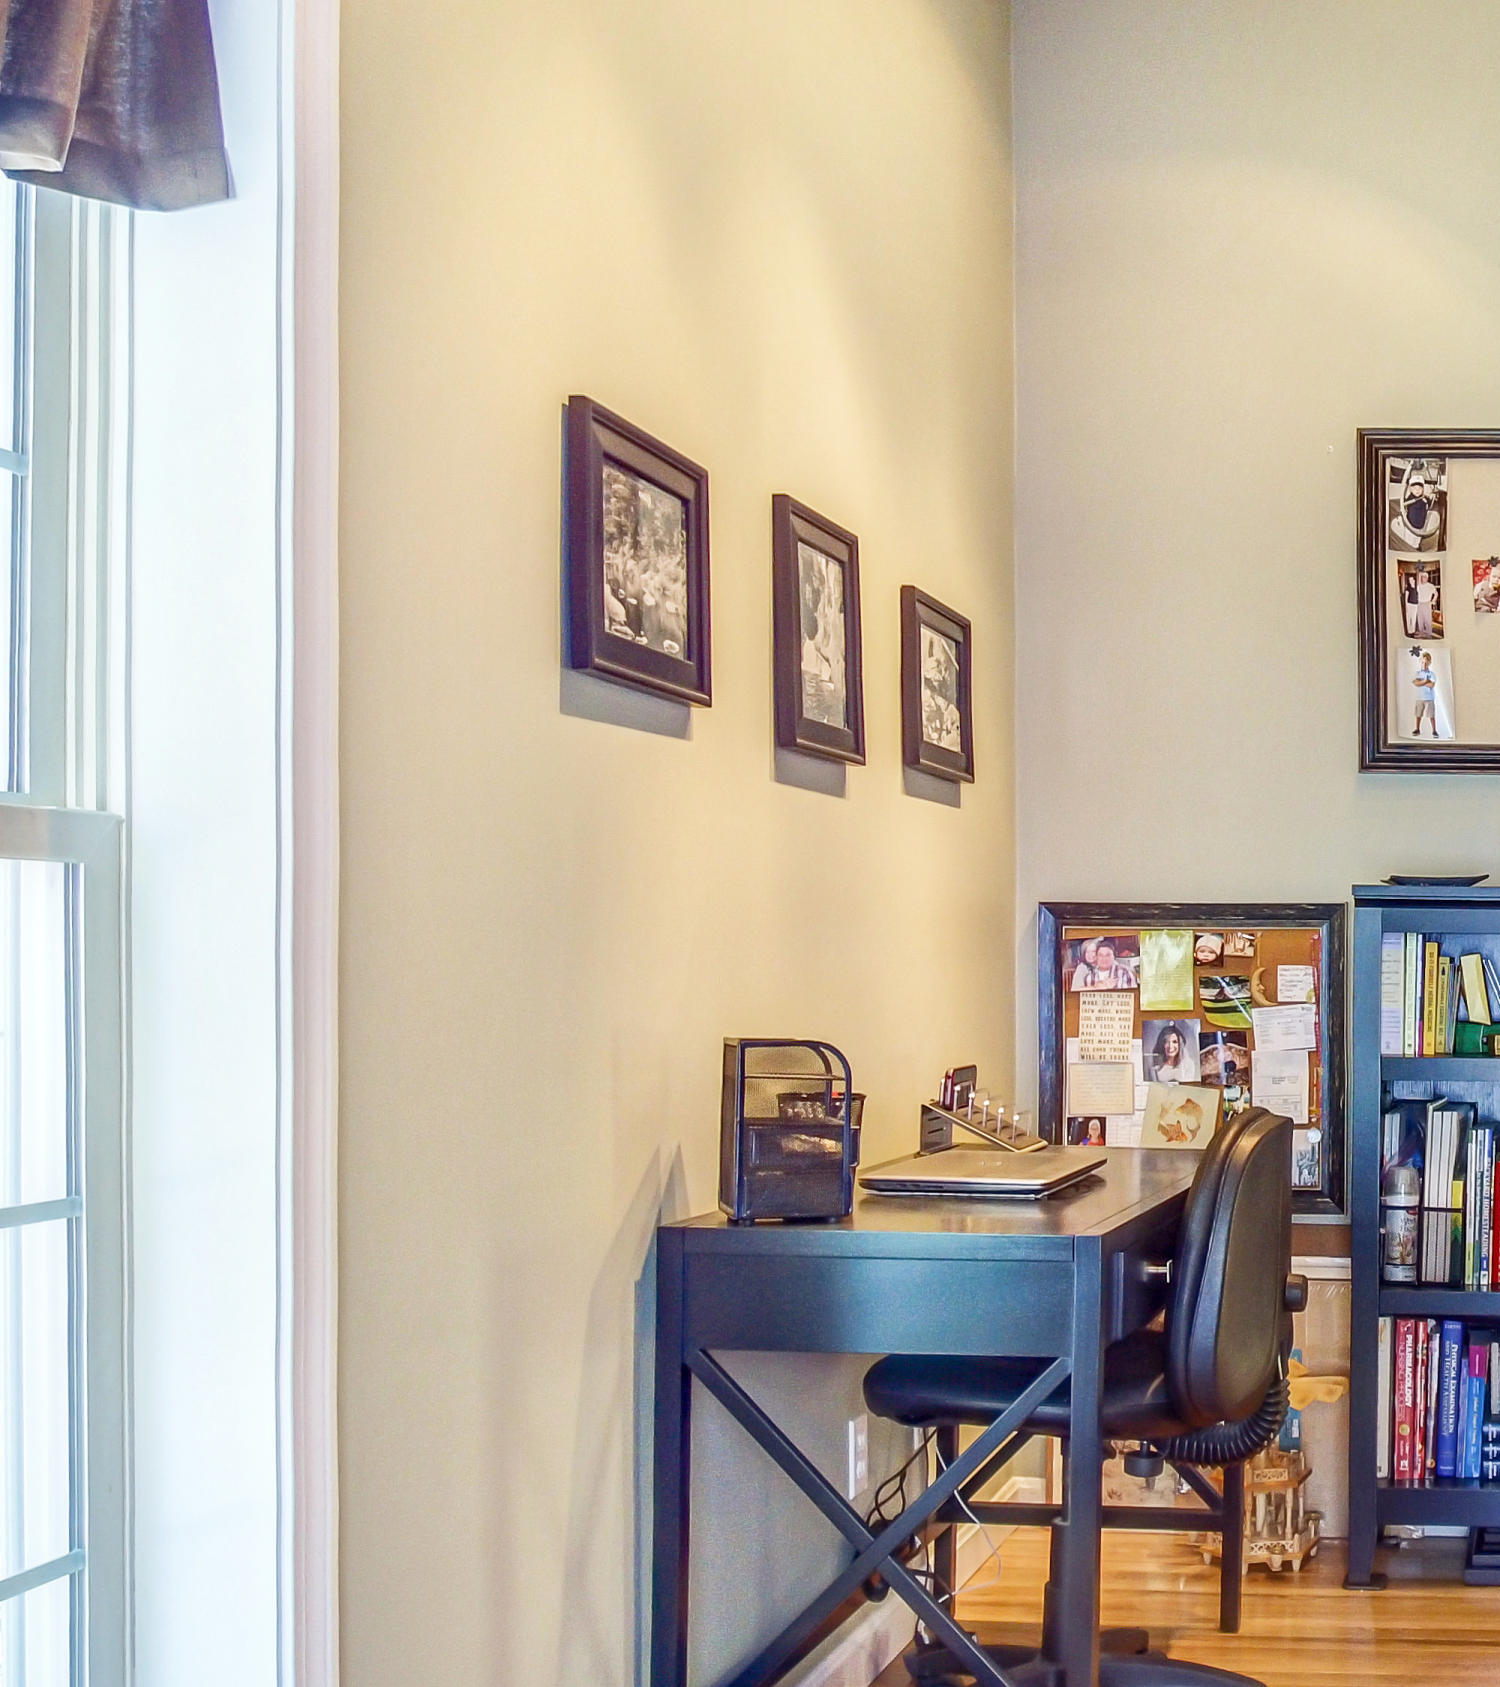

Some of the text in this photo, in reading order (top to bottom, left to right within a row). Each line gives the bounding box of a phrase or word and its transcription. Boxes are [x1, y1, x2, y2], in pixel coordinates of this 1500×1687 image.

[1481, 1199, 1490, 1258] HOMESTEADING
[1404, 1334, 1413, 1408] PHARMACOLOGY
[1448, 1344, 1459, 1433] PHYSICAL EXAMINATION
